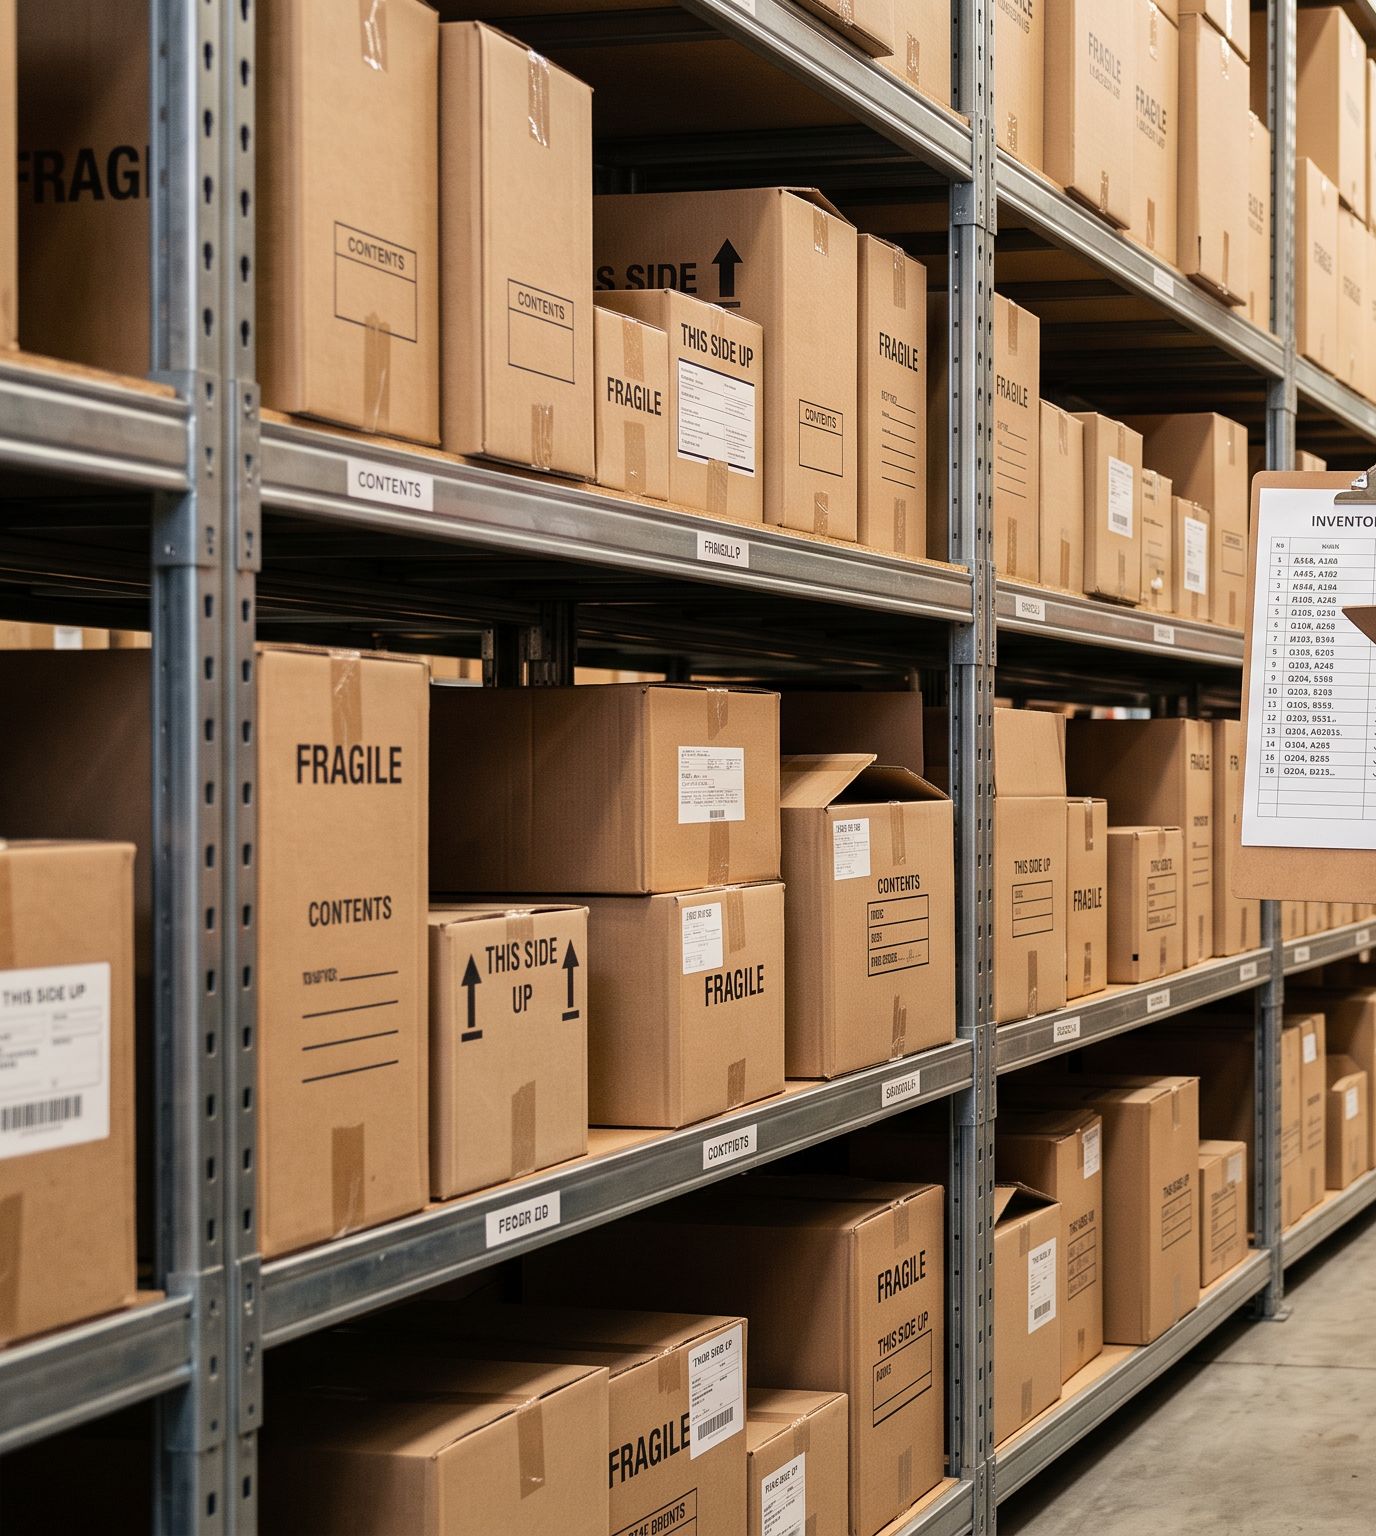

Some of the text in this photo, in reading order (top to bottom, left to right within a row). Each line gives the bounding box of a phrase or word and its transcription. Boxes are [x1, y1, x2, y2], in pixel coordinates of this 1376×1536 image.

[347, 236, 405, 271] CONTENTS
[518, 291, 565, 320] CONTENTS
[681, 322, 754, 369] THIS SIDE UP
[879, 331, 918, 373] FRAGILE
[607, 376, 662, 417] FRAGILE
[358, 471, 421, 498] CONTENTS
[296, 743, 403, 785] FRAGILE
[308, 895, 392, 927] CONTENTS
[485, 937, 557, 975] THIS SIDE
[3, 983, 86, 1006] THIS SIDE UP
[512, 983, 533, 1014] UP
[704, 964, 764, 1007] FRAGILE
[877, 1249, 926, 1304] FRAGILE
[877, 1310, 929, 1357] THIS SIDE UP
[609, 1411, 690, 1489] FRAGILE
